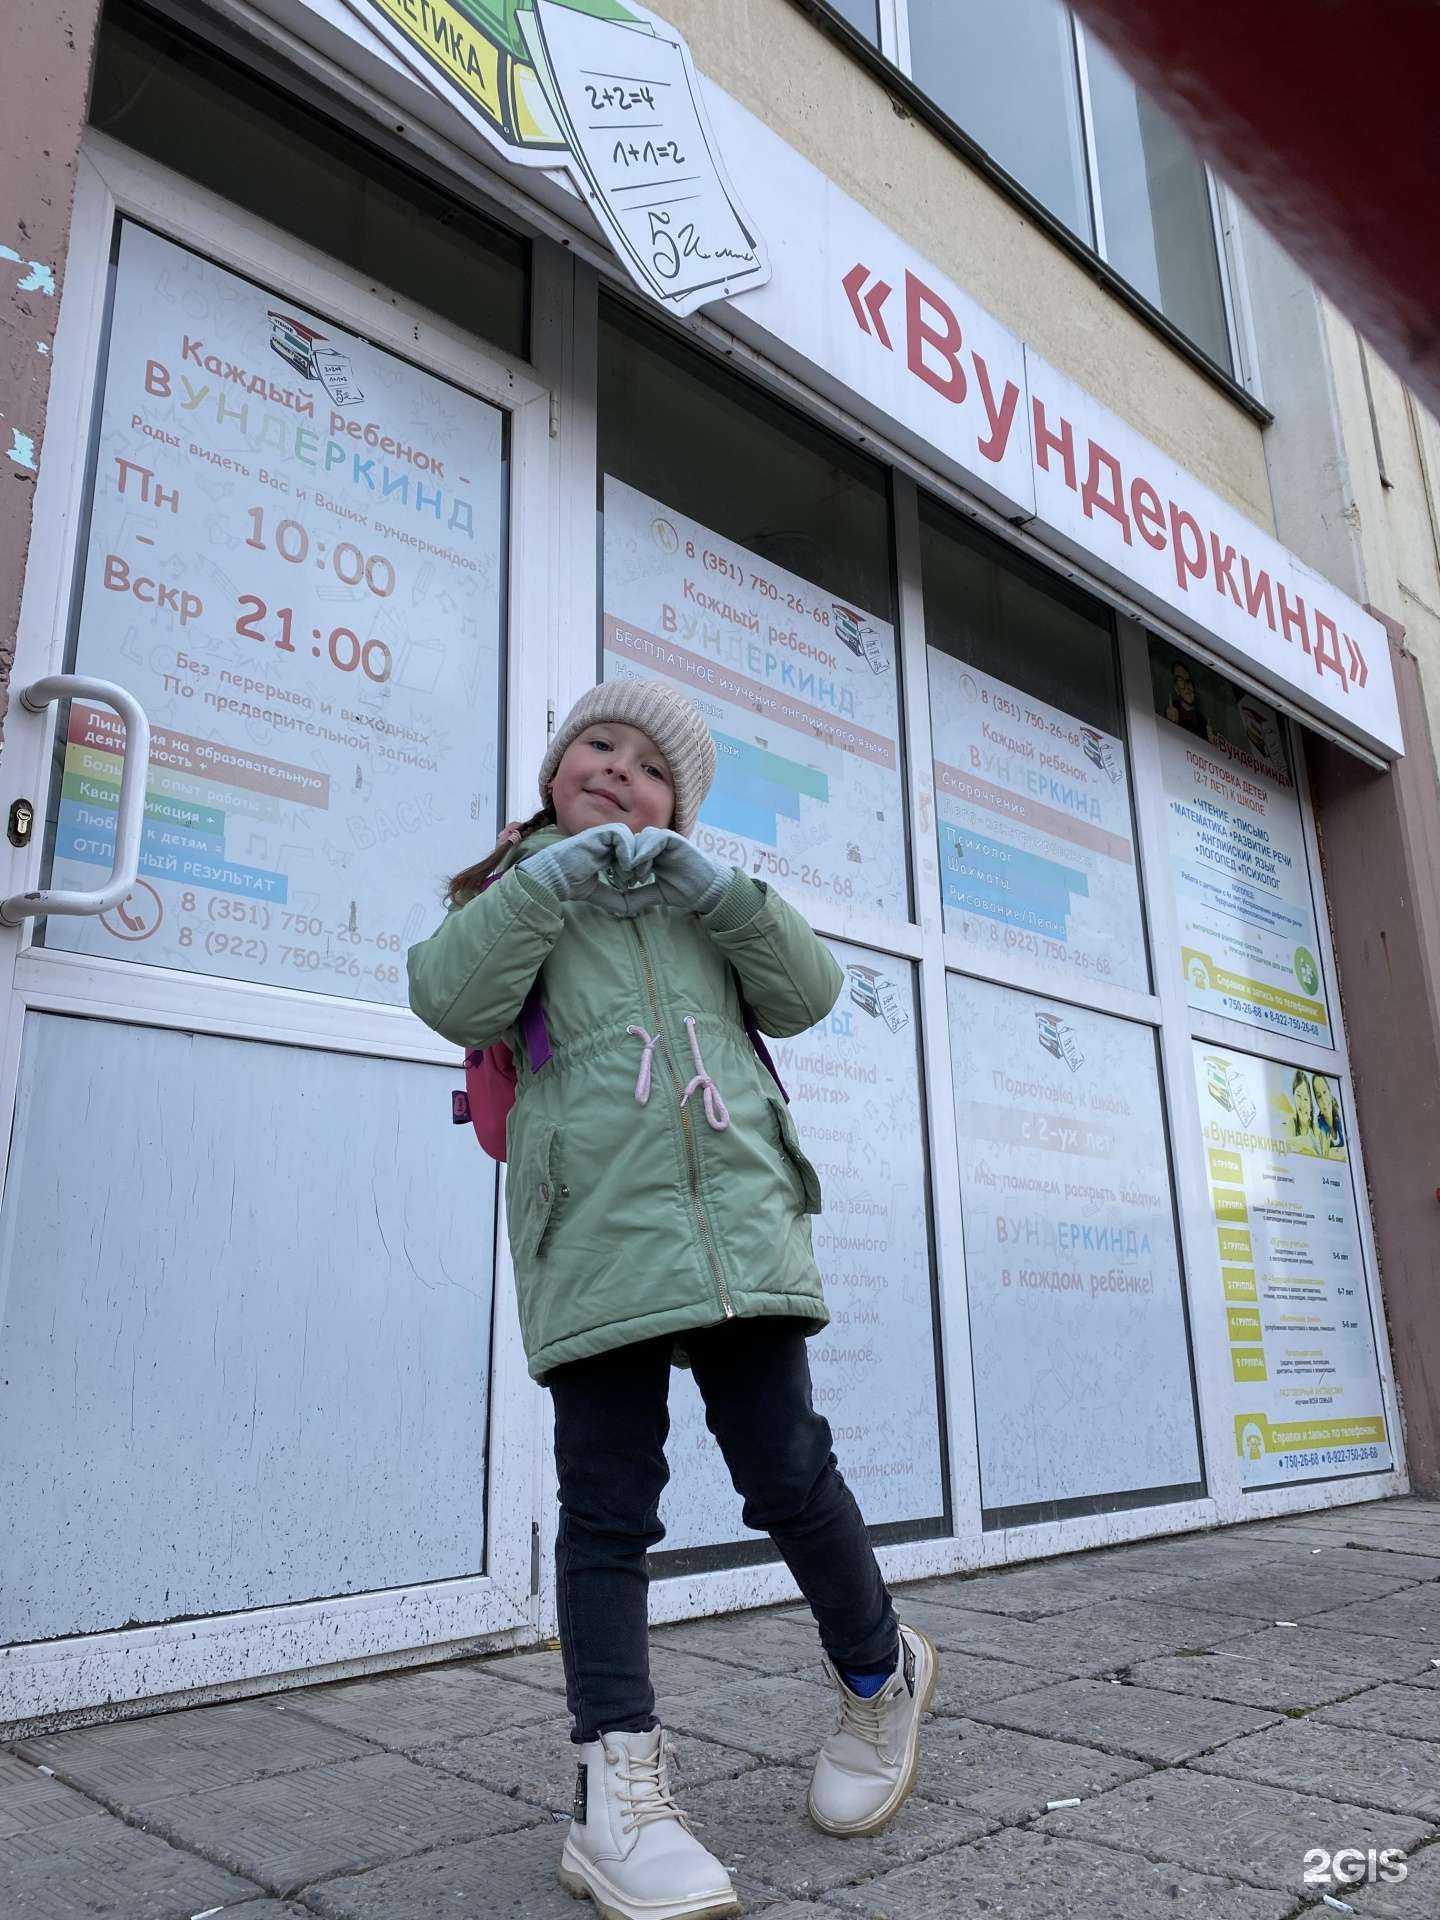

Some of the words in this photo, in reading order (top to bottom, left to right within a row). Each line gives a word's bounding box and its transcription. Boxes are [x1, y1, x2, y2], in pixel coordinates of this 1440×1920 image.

[397, 0, 486, 90] ЕТИКА
[585, 85, 656, 110] 2+2=4
[613, 140, 685, 166] 1+1=2
[181, 334, 315, 420] Каждый
[330, 408, 445, 479] ребенок
[144, 359, 475, 540] ВУНДЕРКИНД
[131, 415, 181, 449] Рады
[188, 442, 251, 478] видеть
[259, 468, 289, 493] Вас
[296, 488, 307, 501] и
[315, 492, 367, 525] Ваших
[374, 518, 482, 573] вундеркиндов:
[841, 263, 1369, 694] «Вундеркинд»
[114, 456, 180, 514] Пн
[245, 505, 396, 599] 10:00
[684, 541, 696, 560] 8
[703, 549, 744, 587] (351)
[750, 573, 831, 628] 750-26-68
[103, 554, 203, 626] Вскр
[235, 593, 393, 683] 21:00
[683, 578, 760, 633] Каждый
[768, 624, 837, 670] ребенок
[616, 627, 715, 684] БЕСПЛАТНОЕ
[719, 676, 777, 710] изучение
[782, 705, 855, 744] английского
[661, 604, 855, 718] ВУНДЕРКИНД
[162, 673, 194, 699] По
[204, 690, 371, 754] предварительной
[378, 741, 438, 774] записи
[176, 651, 211, 677] Без
[219, 668, 312, 711] перерыва
[321, 701, 332, 716] и
[340, 708, 431, 747] выходных
[981, 690, 988, 703] 8
[993, 694, 1022, 722] (351)
[1024, 710, 1080, 749] 750-26-68
[83, 754, 154, 786] Больй
[161, 777, 200, 795] опыт
[85, 731, 193, 768] деятеность
[88, 713, 166, 746] Лицеия
[172, 738, 190, 753] на
[195, 745, 322, 789] образовательную
[982, 721, 1034, 760] Каждый
[1040, 751, 1088, 782] ребенок
[1186, 750, 1242, 791] ПОДГОТОВКА
[80, 782, 199, 823] Кваликация
[943, 772, 1026, 817] Скорочтение
[970, 745, 1103, 822] ВУНДЕРКИНД
[1237, 792, 1266, 816] ШКОЛЕ
[147, 829, 155, 840] к
[161, 831, 208, 852] детям
[946, 828, 1012, 862] Психолог
[1174, 802, 1228, 836] МАТЕМАТИКА
[1233, 831, 1272, 859] РАЗВИТИЕ
[1273, 850, 1292, 869] РЕЧИ
[1197, 798, 1230, 823] ЧТЕНИЕ
[1237, 818, 1270, 842] ПИСЬМО
[73, 838, 177, 872] ОТЛНЫЙ
[184, 862, 276, 892] РЕЗУЛЬТАТ
[696, 828, 749, 867] (922)
[753, 849, 855, 897] 750-26-68
[947, 855, 1010, 891] Шахматы
[1199, 845, 1237, 873] ЛОГОПЕД
[1241, 863, 1280, 889] ПСИХОЛОГ
[1201, 832, 1252, 864] АНГЛИЙСКИЙ
[1255, 856, 1276, 875] ЯЗЫК
[181, 891, 196, 912] 8
[207, 896, 271, 930] (351)
[280, 910, 401, 951] 750-26-68
[178, 926, 193, 947] 8
[204, 931, 269, 965] (922)
[279, 944, 400, 984] 750-26-68
[990, 926, 998, 940] 8
[1004, 928, 1039, 956] (922)
[1043, 939, 1111, 975] 750-26-68
[774, 1045, 877, 1084] Wunderkind
[800, 1125, 854, 1144] еловека
[1038, 1119, 1079, 1151] 2-ух
[1002, 1175, 1060, 1197] поможем
[817, 1236, 888, 1253] огромного
[1019, 1269, 1084, 1292] каждом
[1090, 1270, 1154, 1298] ребёнке!
[1284, 1453, 1320, 1469] 750-26-68
